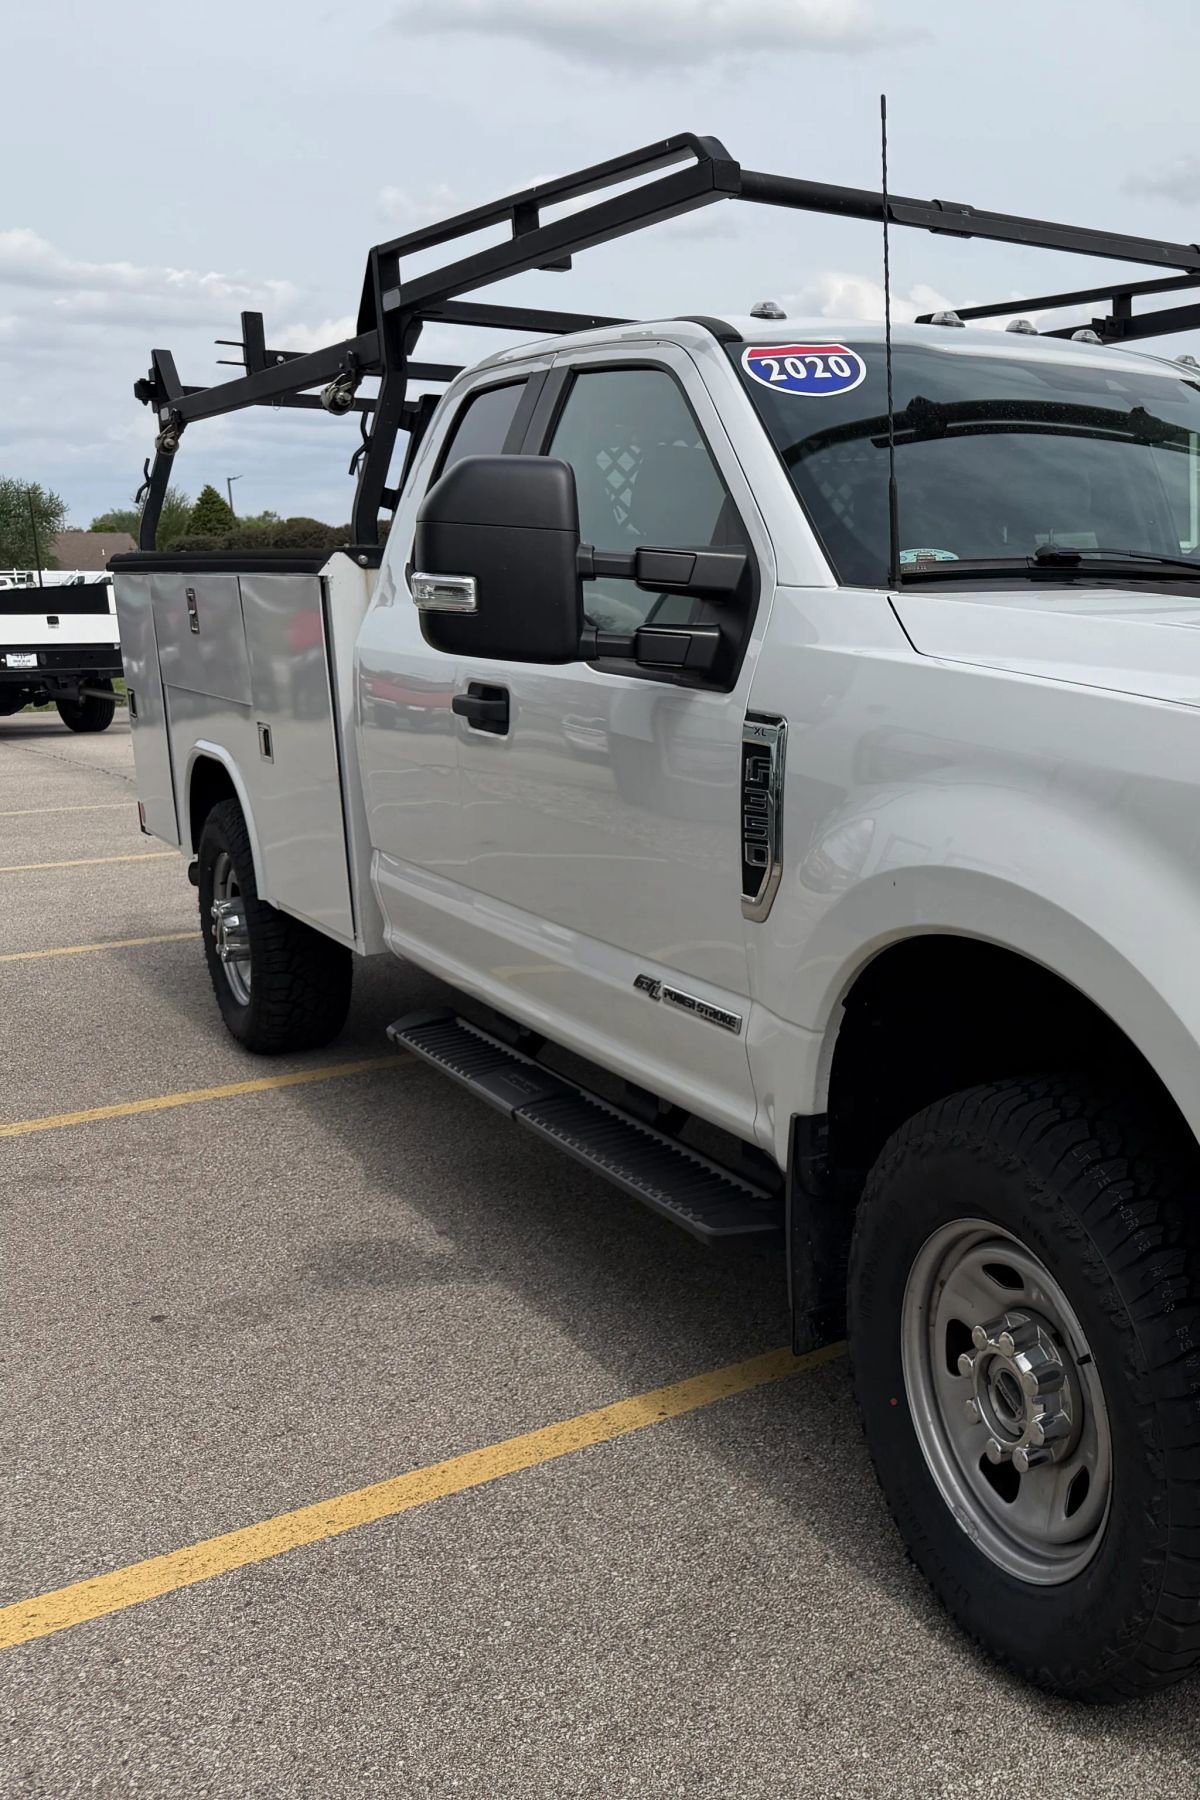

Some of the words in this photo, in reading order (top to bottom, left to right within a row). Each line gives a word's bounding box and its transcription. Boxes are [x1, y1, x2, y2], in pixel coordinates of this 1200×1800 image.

[760, 355, 852, 382] 2020
[753, 727, 767, 737] XL
[663, 987, 696, 1010] POWER
[696, 1002, 737, 1028] STROKE
